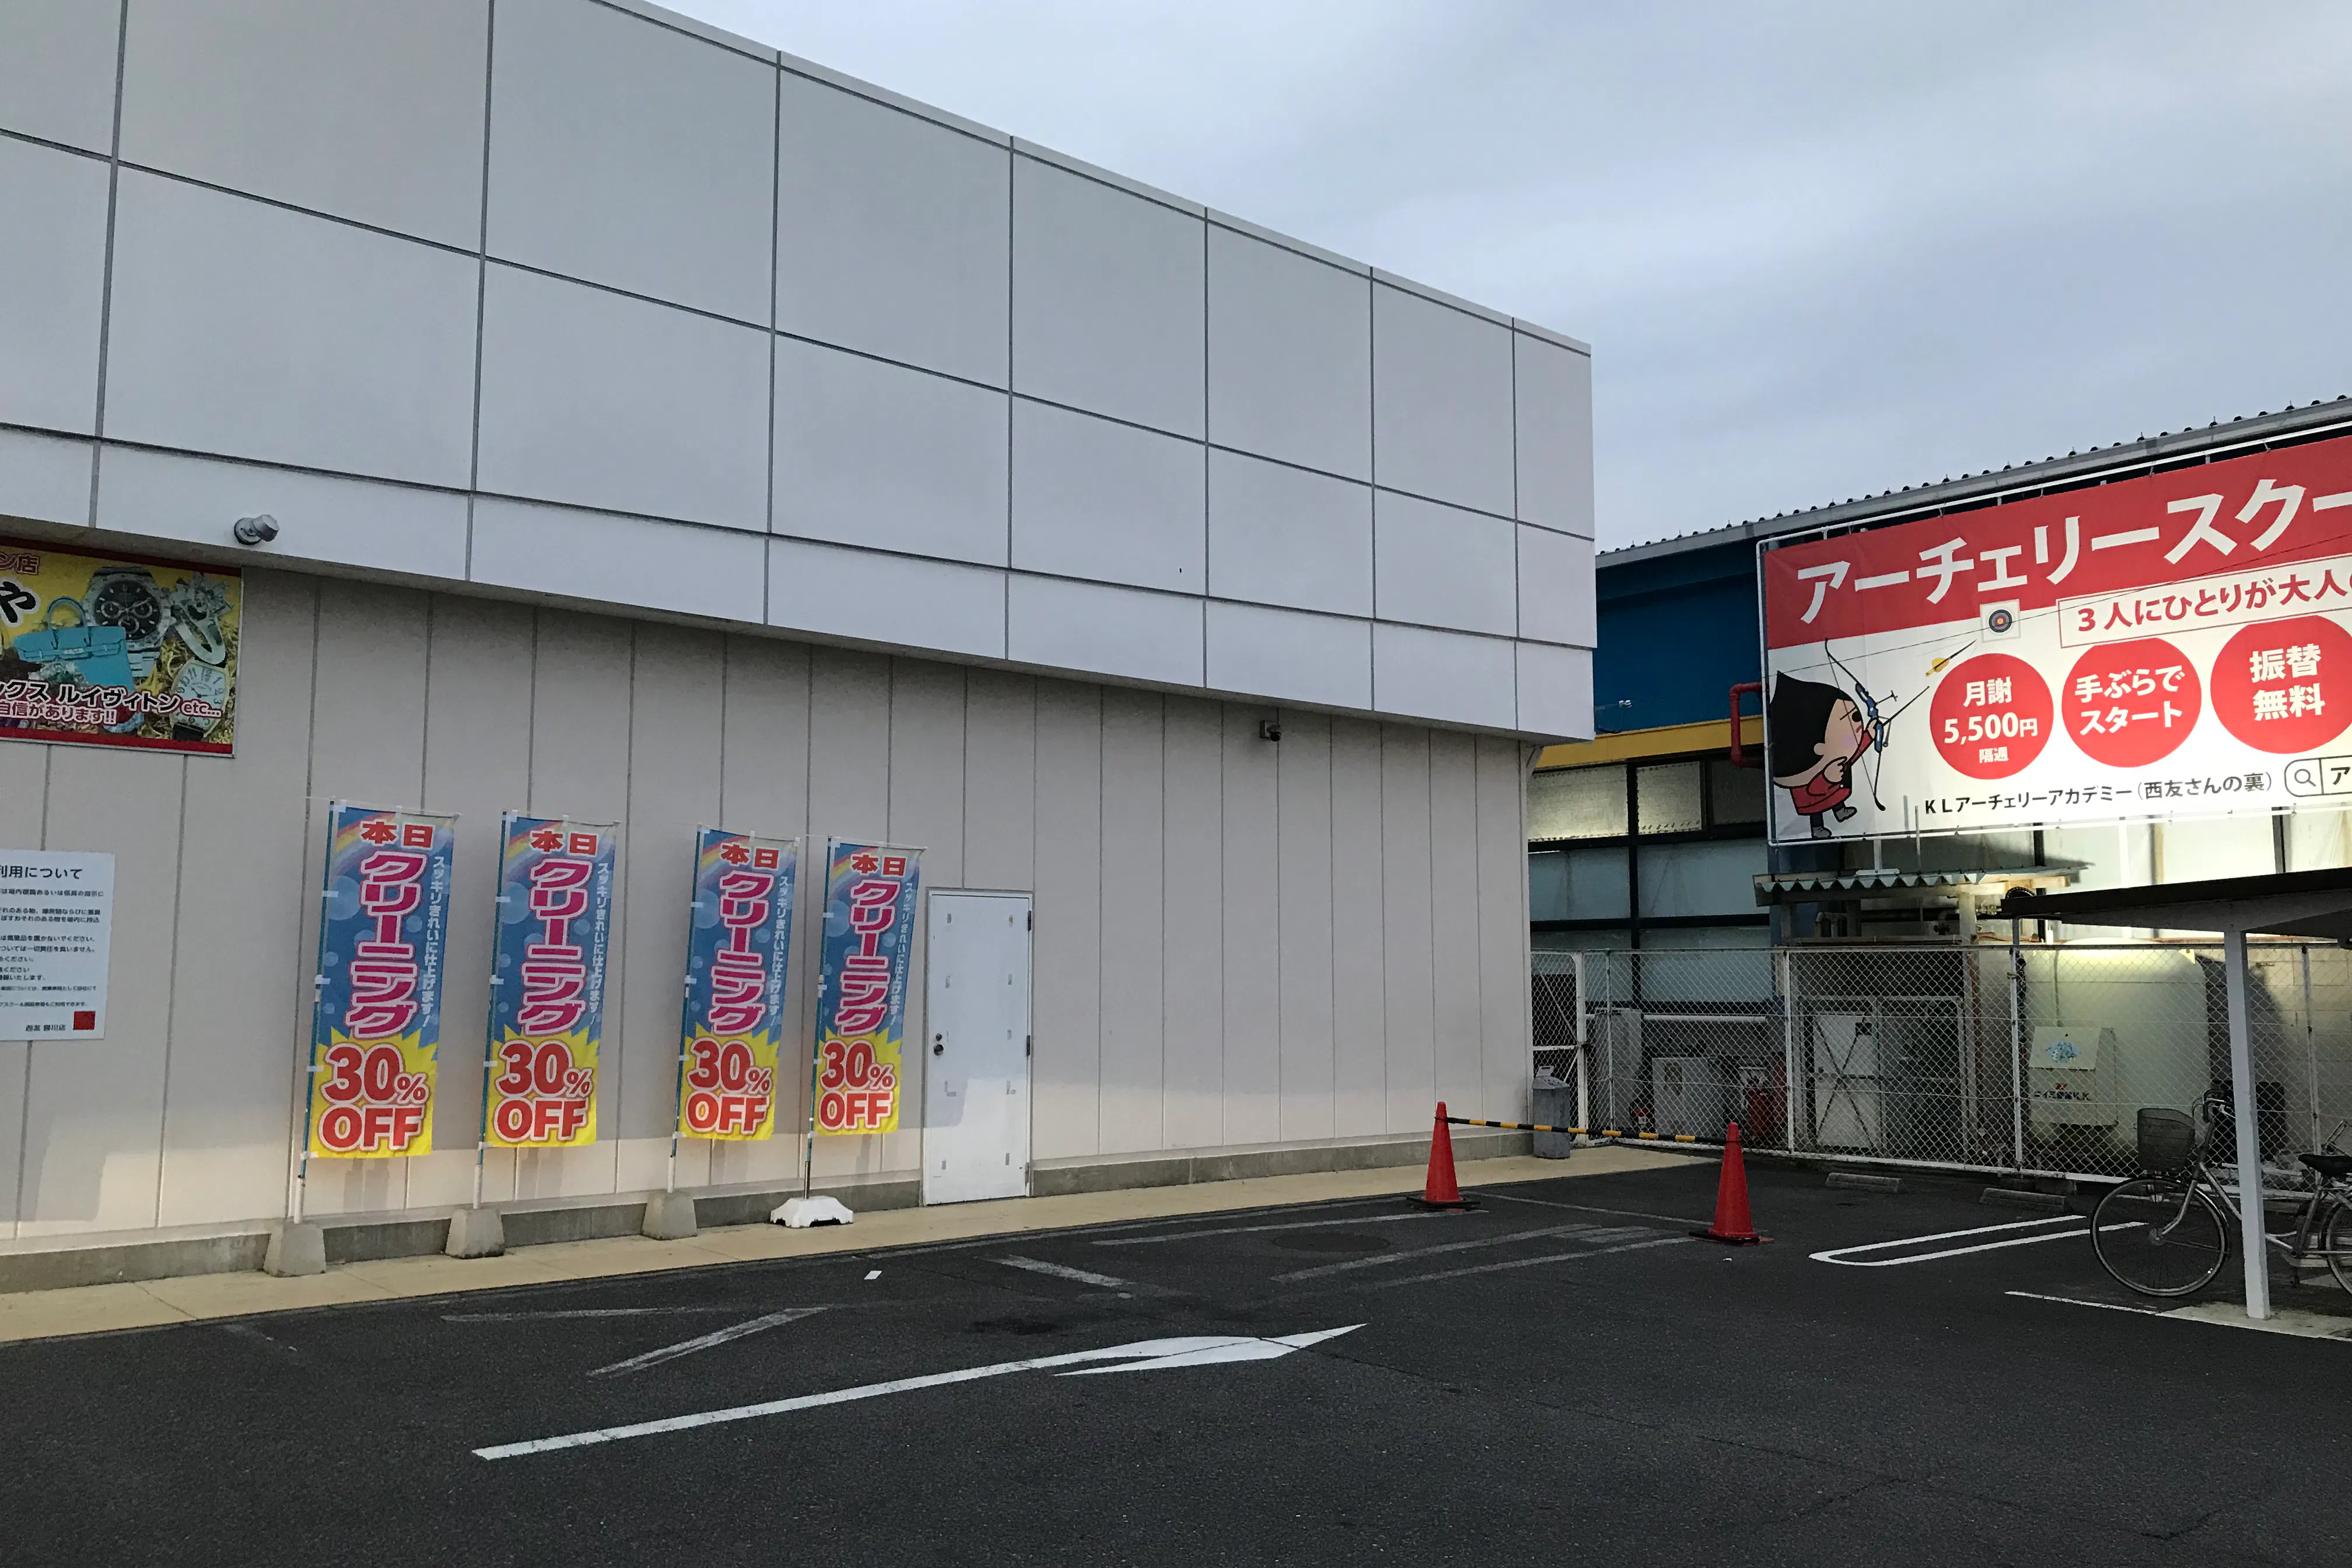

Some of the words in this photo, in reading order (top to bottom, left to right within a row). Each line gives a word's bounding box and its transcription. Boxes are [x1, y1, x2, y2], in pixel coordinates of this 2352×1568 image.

[2077, 569, 2352, 631] 3人にひとりが大人
[2249, 643, 2322, 682] 振替
[1963, 676, 2013, 707] 月謝
[2074, 665, 2186, 704] 手ぶらで
[2253, 683, 2326, 722] 無料
[1944, 712, 2038, 746] 5,500円
[2080, 701, 2183, 736] スタート
[1979, 747, 2008, 764] 隔週
[2330, 766, 2351, 785] ア
[361, 821, 432, 848] 本日
[531, 830, 597, 855] 本日
[721, 843, 779, 869] 本日
[852, 854, 907, 876] 本日
[346, 851, 427, 1038] クリーニング
[517, 859, 593, 1036] クリーニング
[708, 871, 774, 1035] クリーニング
[835, 879, 901, 1035] クリーニング
[320, 1043, 428, 1105] 30%
[495, 1041, 593, 1098] 30%
[688, 1038, 773, 1094] 30%
[820, 1040, 895, 1090] 30%
[318, 1105, 424, 1151] OFF
[493, 1099, 589, 1142] OFF
[686, 1093, 769, 1135] OFF
[819, 1091, 893, 1132] OFF
